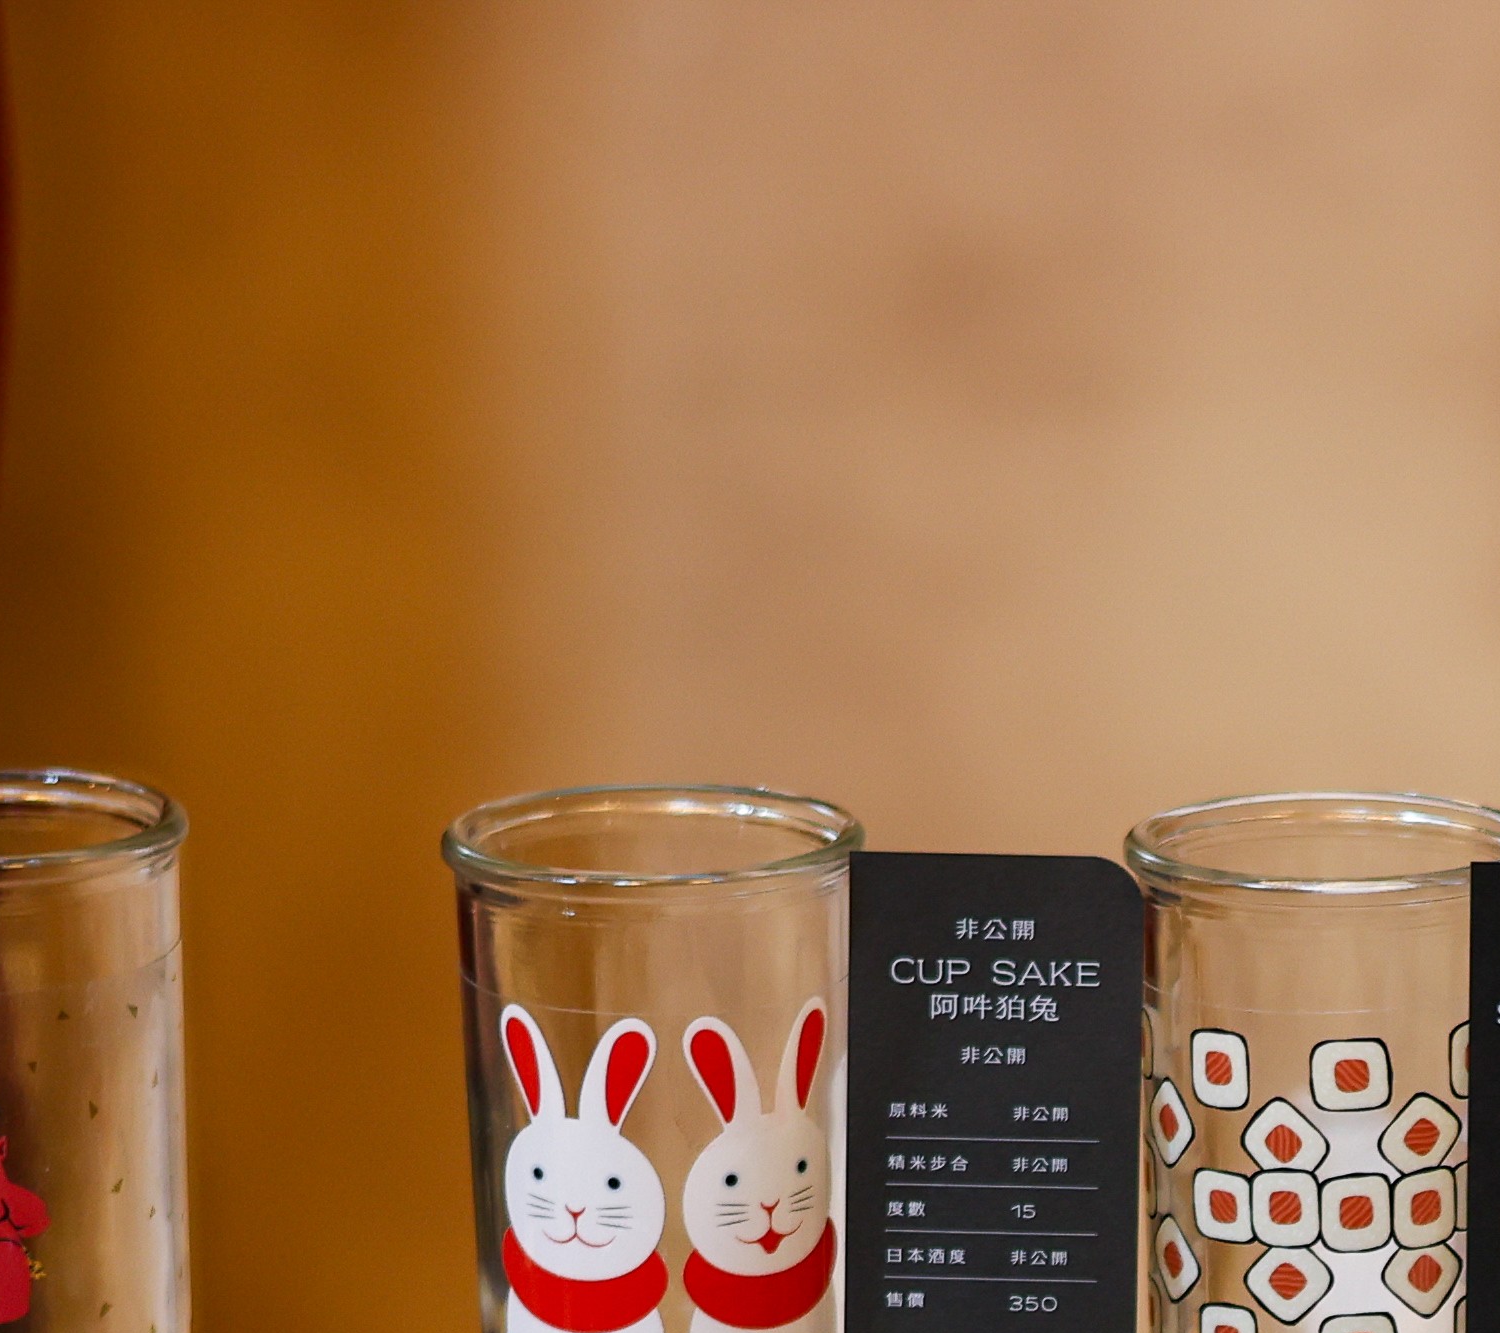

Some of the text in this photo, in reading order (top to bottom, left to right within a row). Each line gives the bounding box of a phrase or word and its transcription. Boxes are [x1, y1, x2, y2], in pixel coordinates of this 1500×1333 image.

[956, 918, 1034, 940] 非公開
[891, 958, 1100, 986] CUP SAKE
[961, 1046, 1025, 1064] 非公開
[887, 1201, 1035, 1218] 度數 15
[1010, 1296, 1057, 1311] 350
